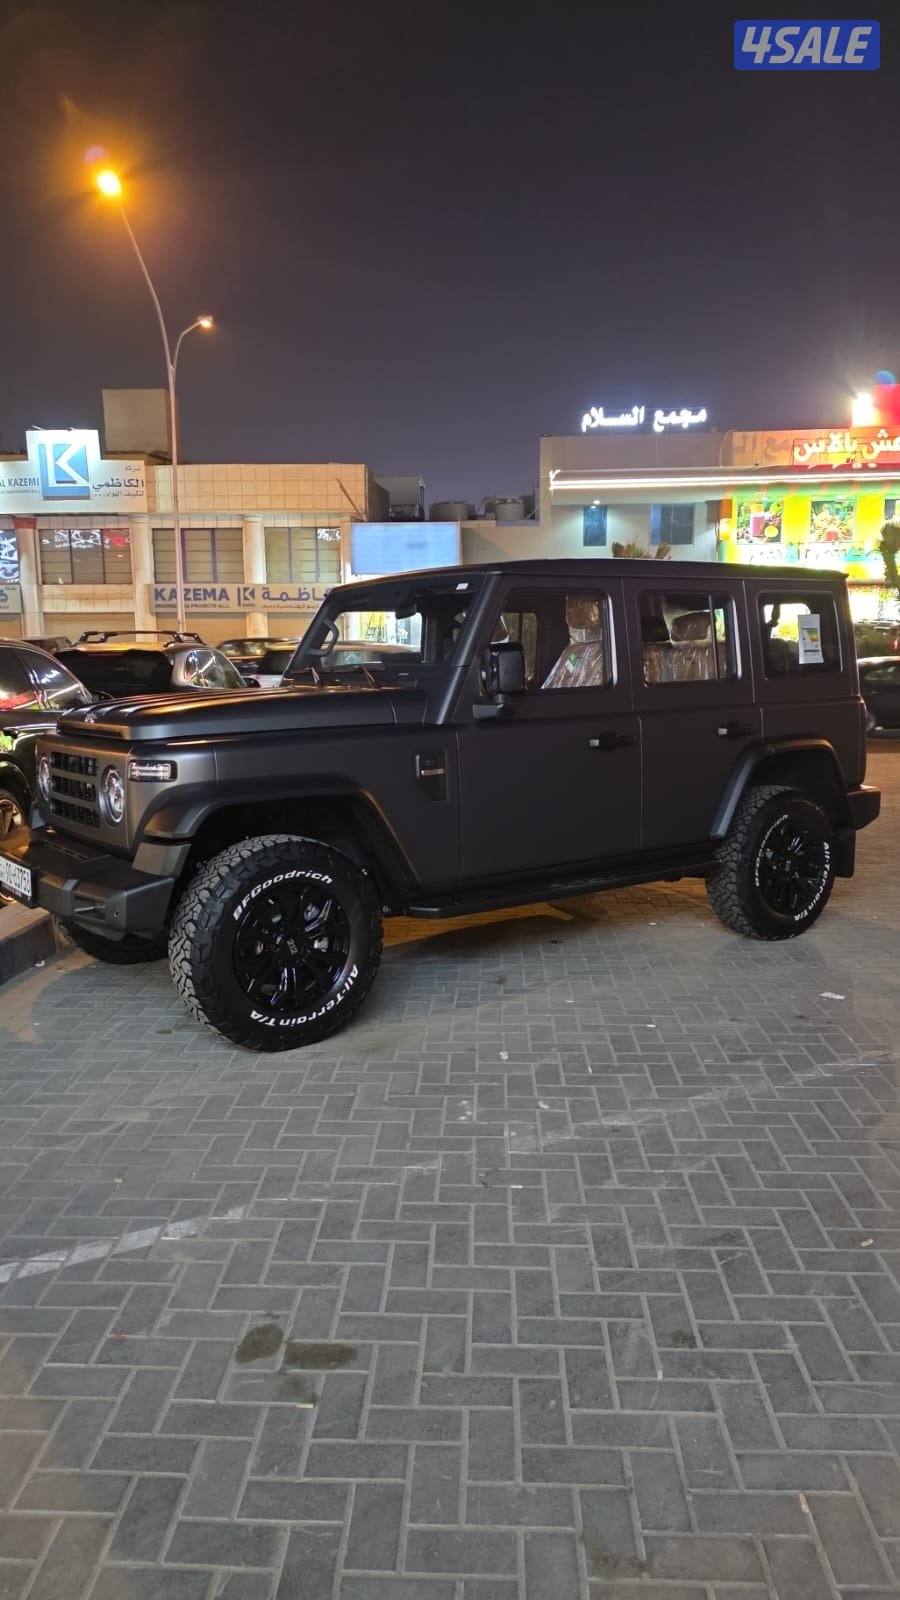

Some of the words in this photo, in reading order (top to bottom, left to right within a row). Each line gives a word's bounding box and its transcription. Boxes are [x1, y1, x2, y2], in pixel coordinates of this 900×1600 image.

[581, 405, 645, 432] السلام
[653, 408, 707, 432] مجمع
[8, 477, 40, 487] KAZEMI
[92, 476, 144, 492] الكاظمي
[154, 587, 230, 601] KAZEMA
[232, 869, 333, 921] BFGoodrich
[280, 963, 359, 1027] All-Terrain
[250, 1009, 276, 1027] T/A
